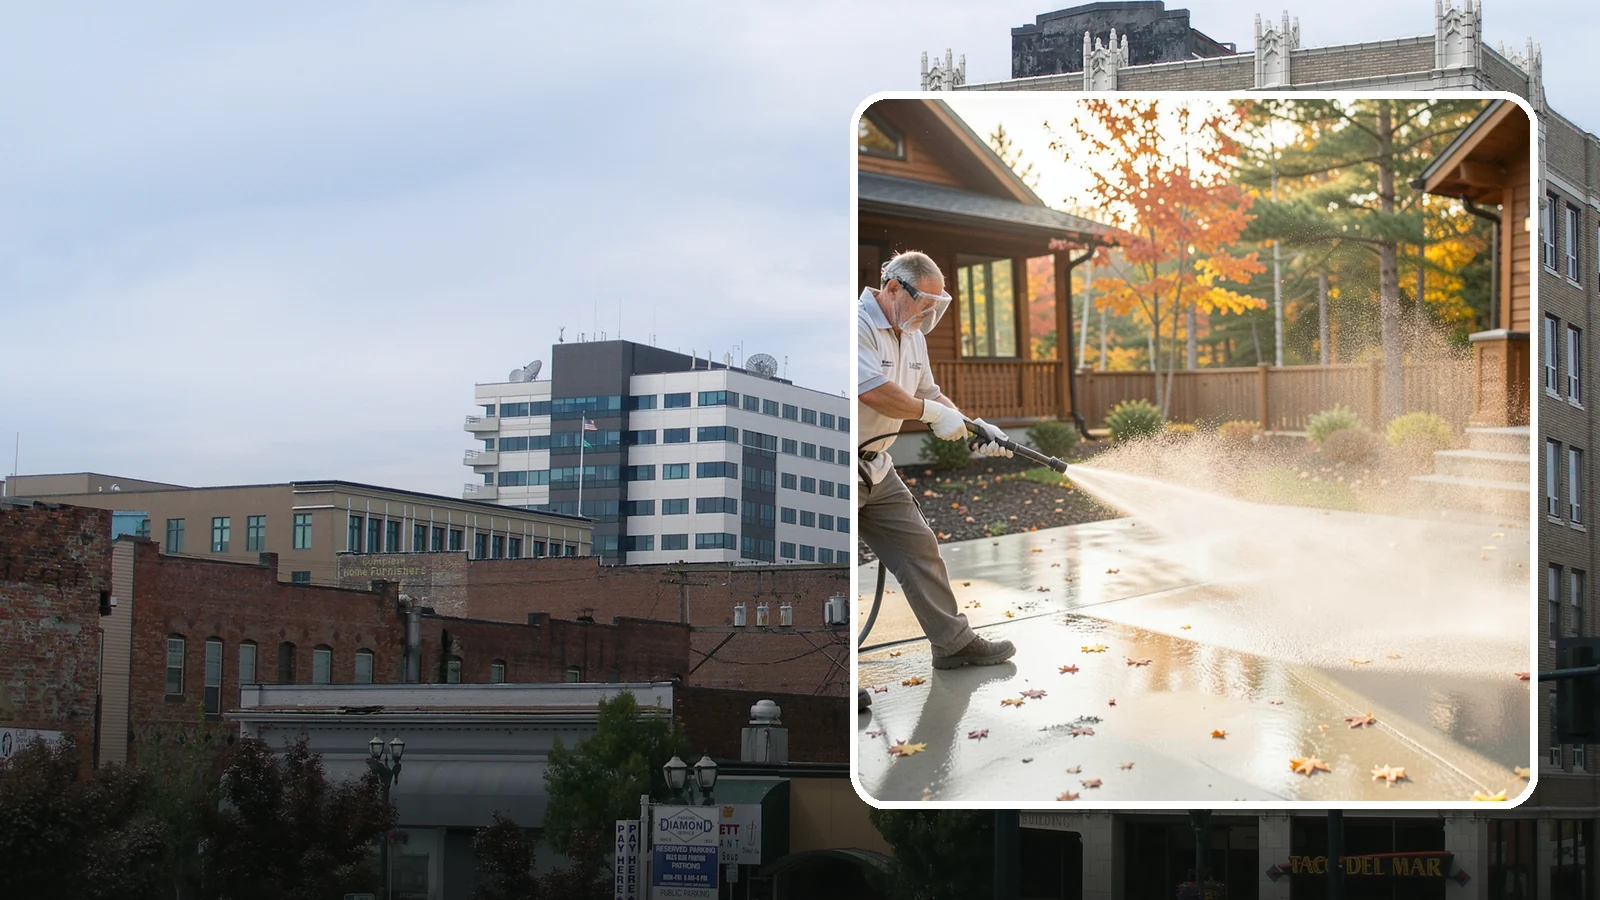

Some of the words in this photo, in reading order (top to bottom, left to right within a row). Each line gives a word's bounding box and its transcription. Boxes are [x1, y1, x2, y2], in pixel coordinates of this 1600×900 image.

[660, 818, 713, 833] DIAMOND
[1022, 815, 1070, 827] BUILDING
[617, 824, 625, 853] PAY
[628, 824, 637, 853] PAY
[656, 845, 688, 853] RESERVED
[689, 846, 716, 854] PARKING
[616, 855, 625, 894] HERE
[627, 855, 636, 894] HERE
[671, 862, 701, 870] PATRONS
[1289, 855, 1329, 874] TAC
[1346, 855, 1385, 876] DEL
[1392, 857, 1443, 877] MAR
[660, 888, 682, 897] PUBLIC
[683, 889, 710, 898] PARKING
